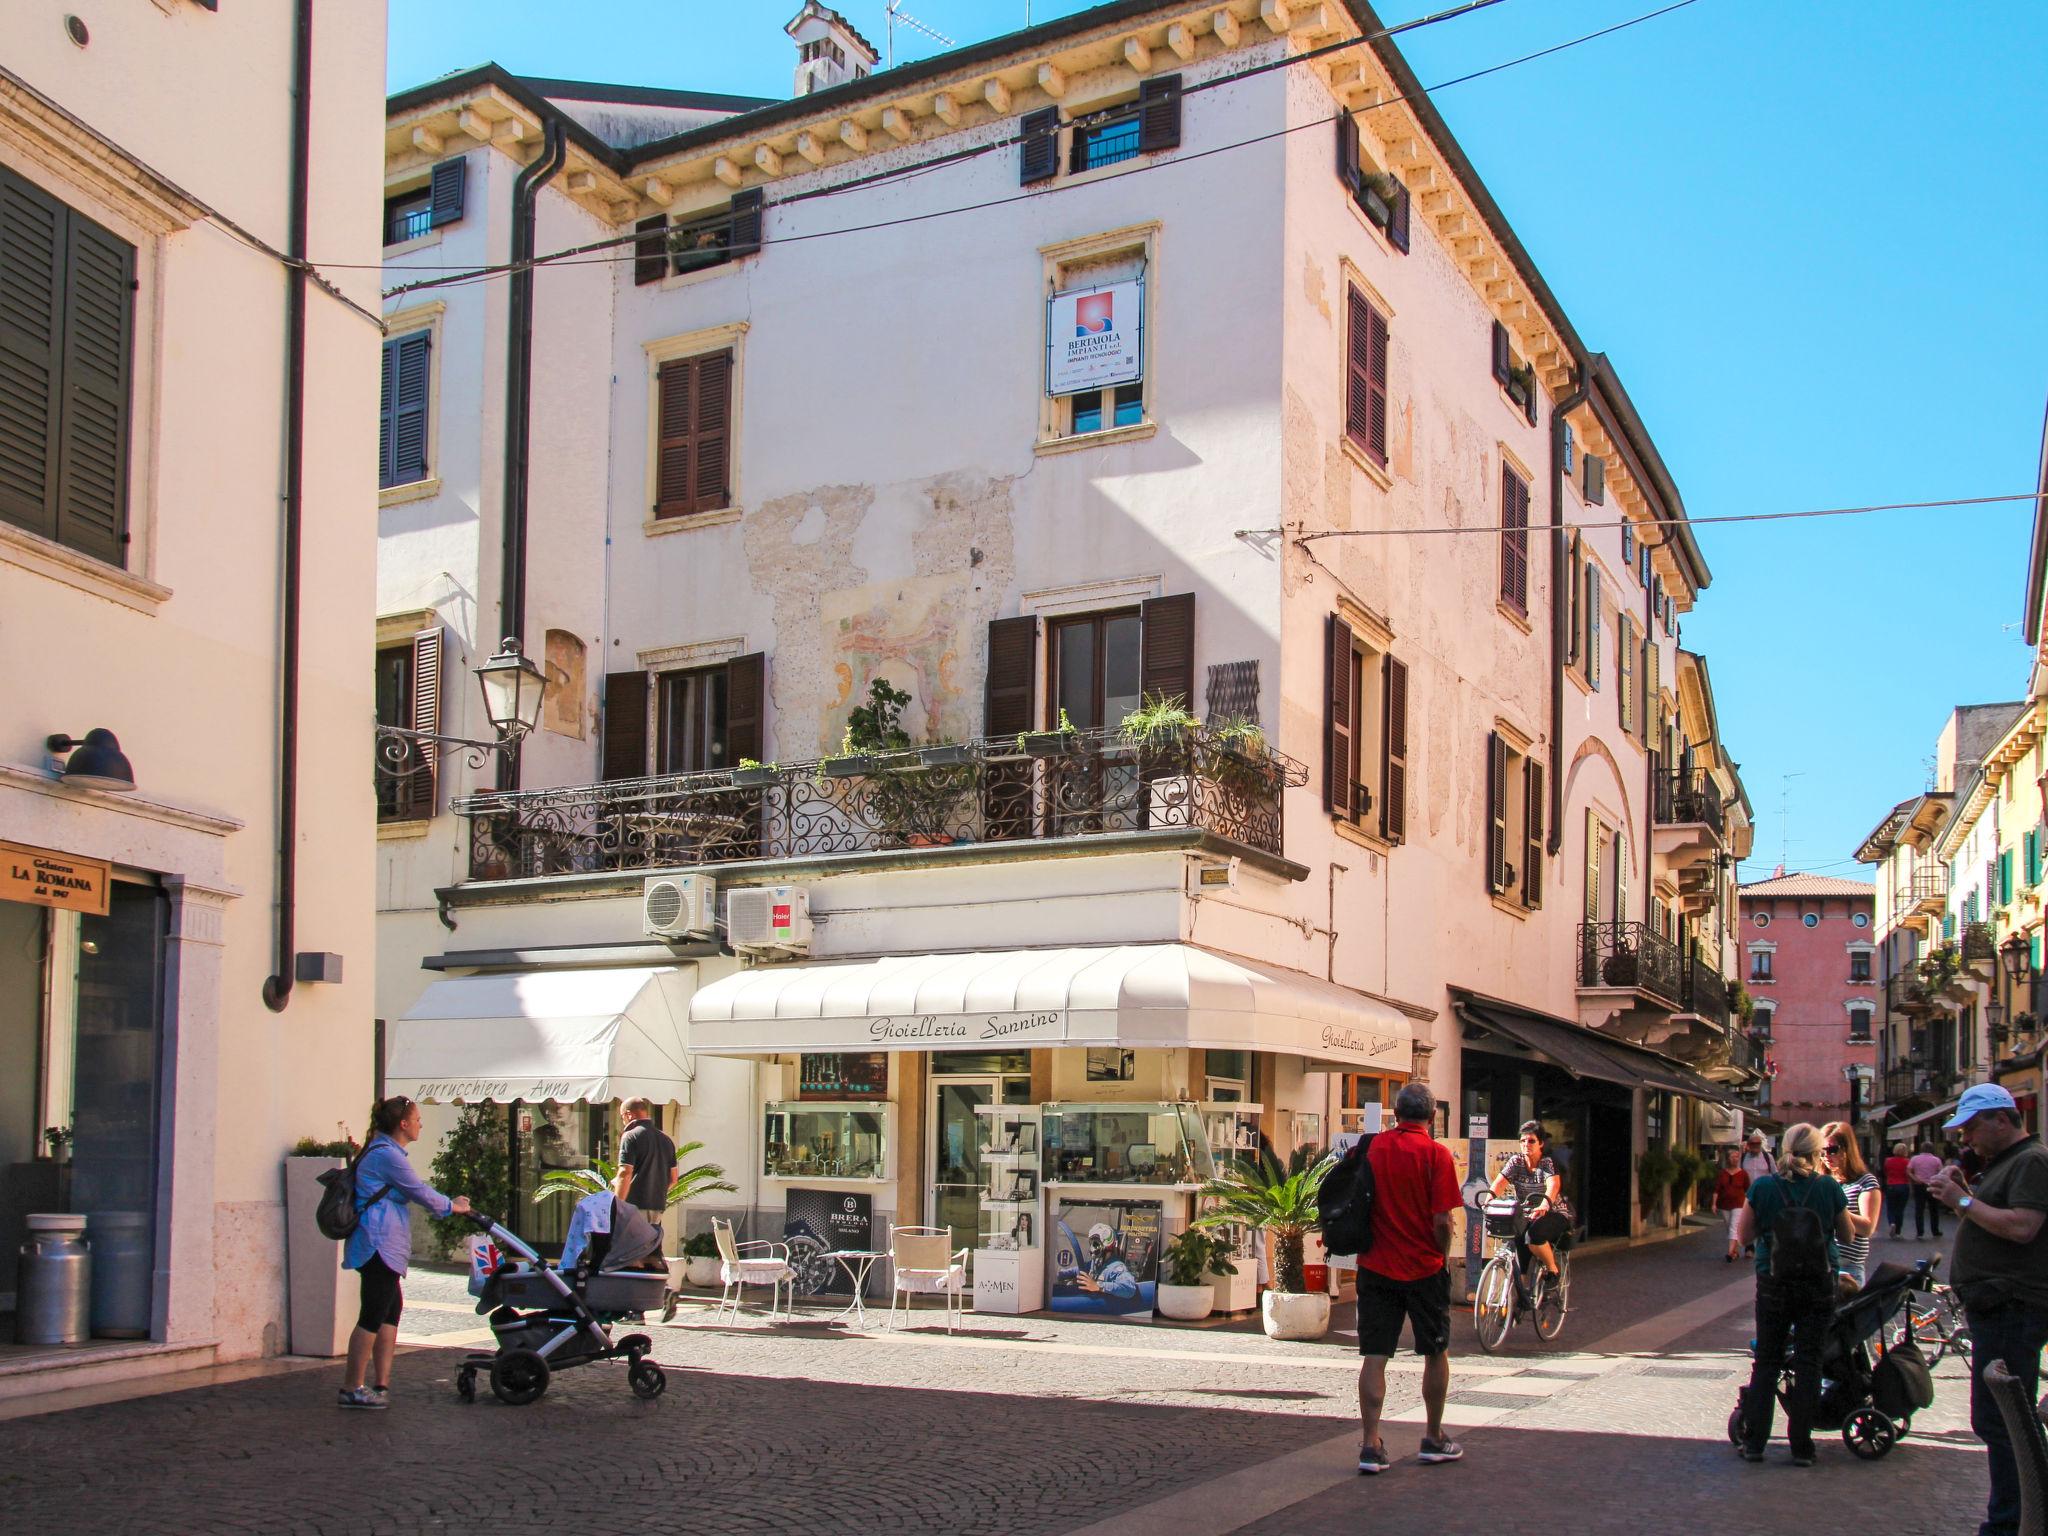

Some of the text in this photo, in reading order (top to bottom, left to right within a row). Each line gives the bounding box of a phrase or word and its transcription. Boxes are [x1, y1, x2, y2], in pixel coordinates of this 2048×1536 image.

[1068, 333, 1121, 350] BERTAIOLA
[1068, 344, 1108, 357] IMPIANTI
[12, 865, 92, 891] LA ROMANA
[870, 1011, 1058, 1041] Gioielleria Sannino
[1321, 1025, 1398, 1057] Gioielleria Sannino
[415, 1079, 570, 1100] parrucchiera Anna
[830, 1213, 868, 1223] BRERA
